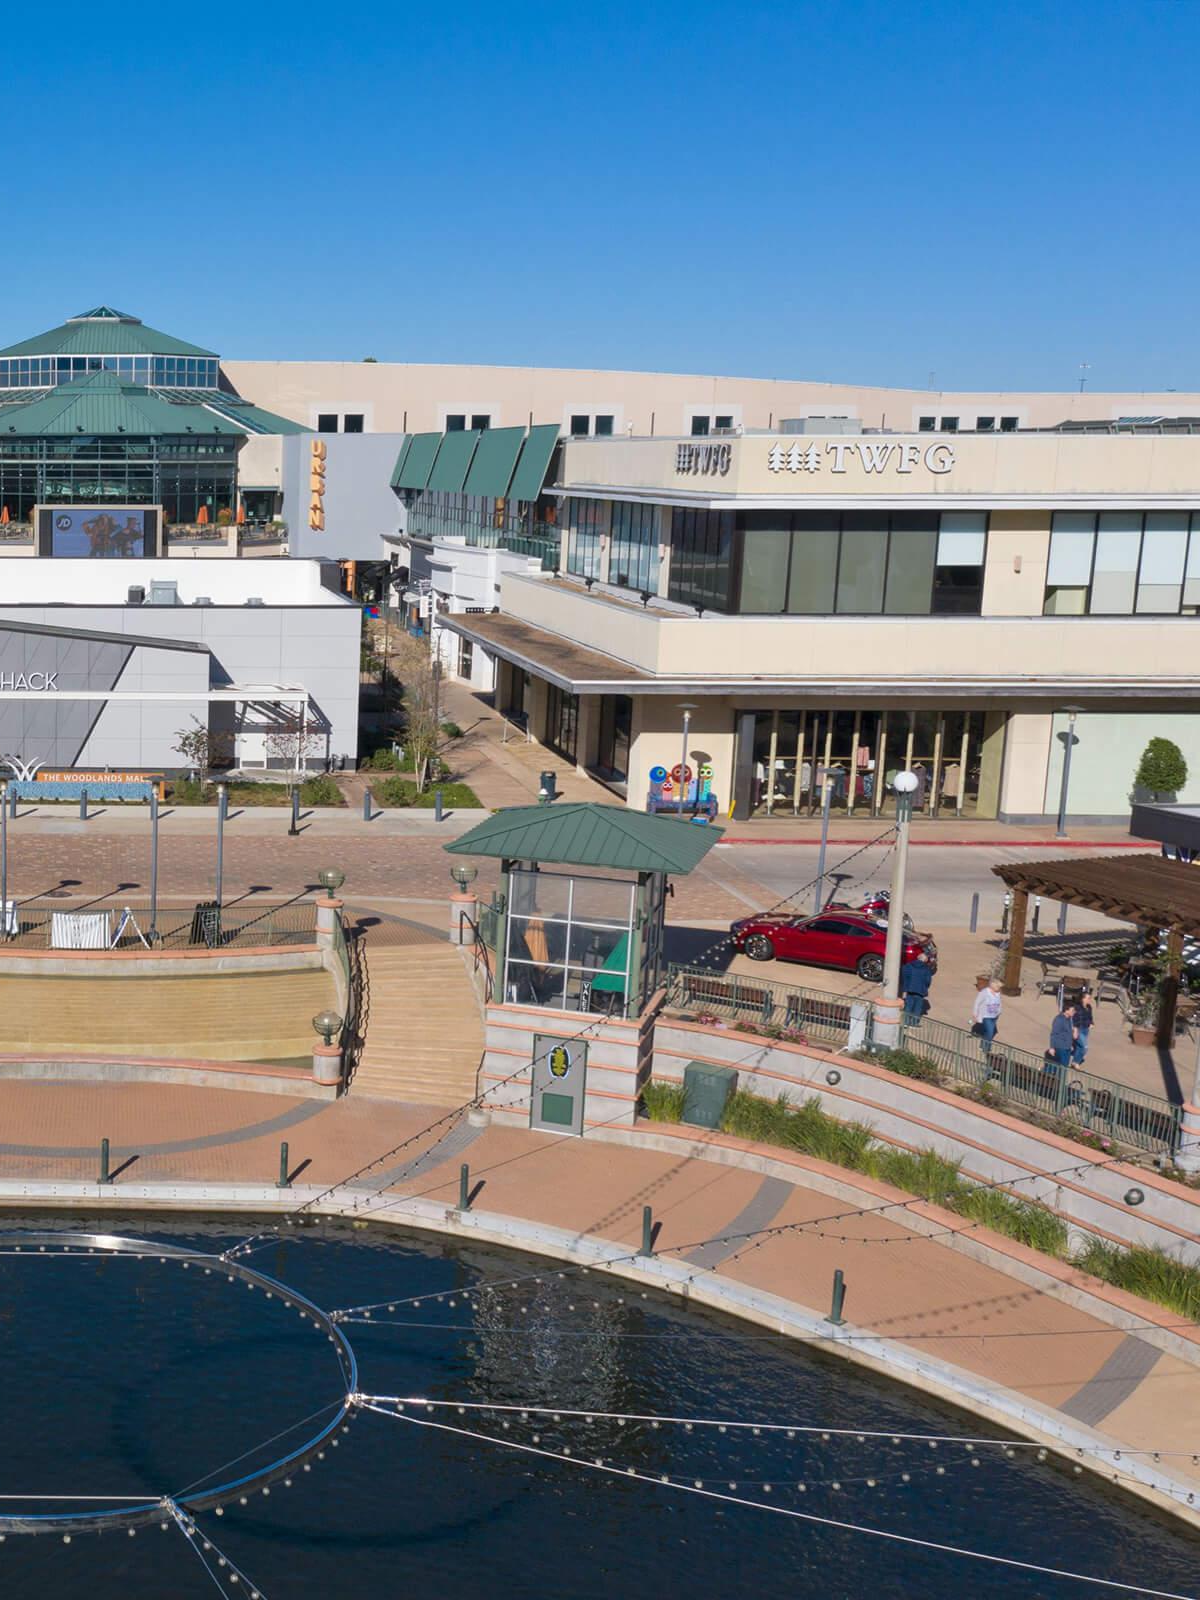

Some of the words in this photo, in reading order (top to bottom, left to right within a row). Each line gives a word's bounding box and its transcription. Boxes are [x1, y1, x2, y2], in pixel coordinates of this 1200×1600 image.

[691, 444, 731, 474] TWFG
[826, 443, 955, 473] TWFG
[310, 440, 326, 529] URBAN
[43, 773, 60, 782] THE
[64, 773, 123, 783] WOODLANDS
